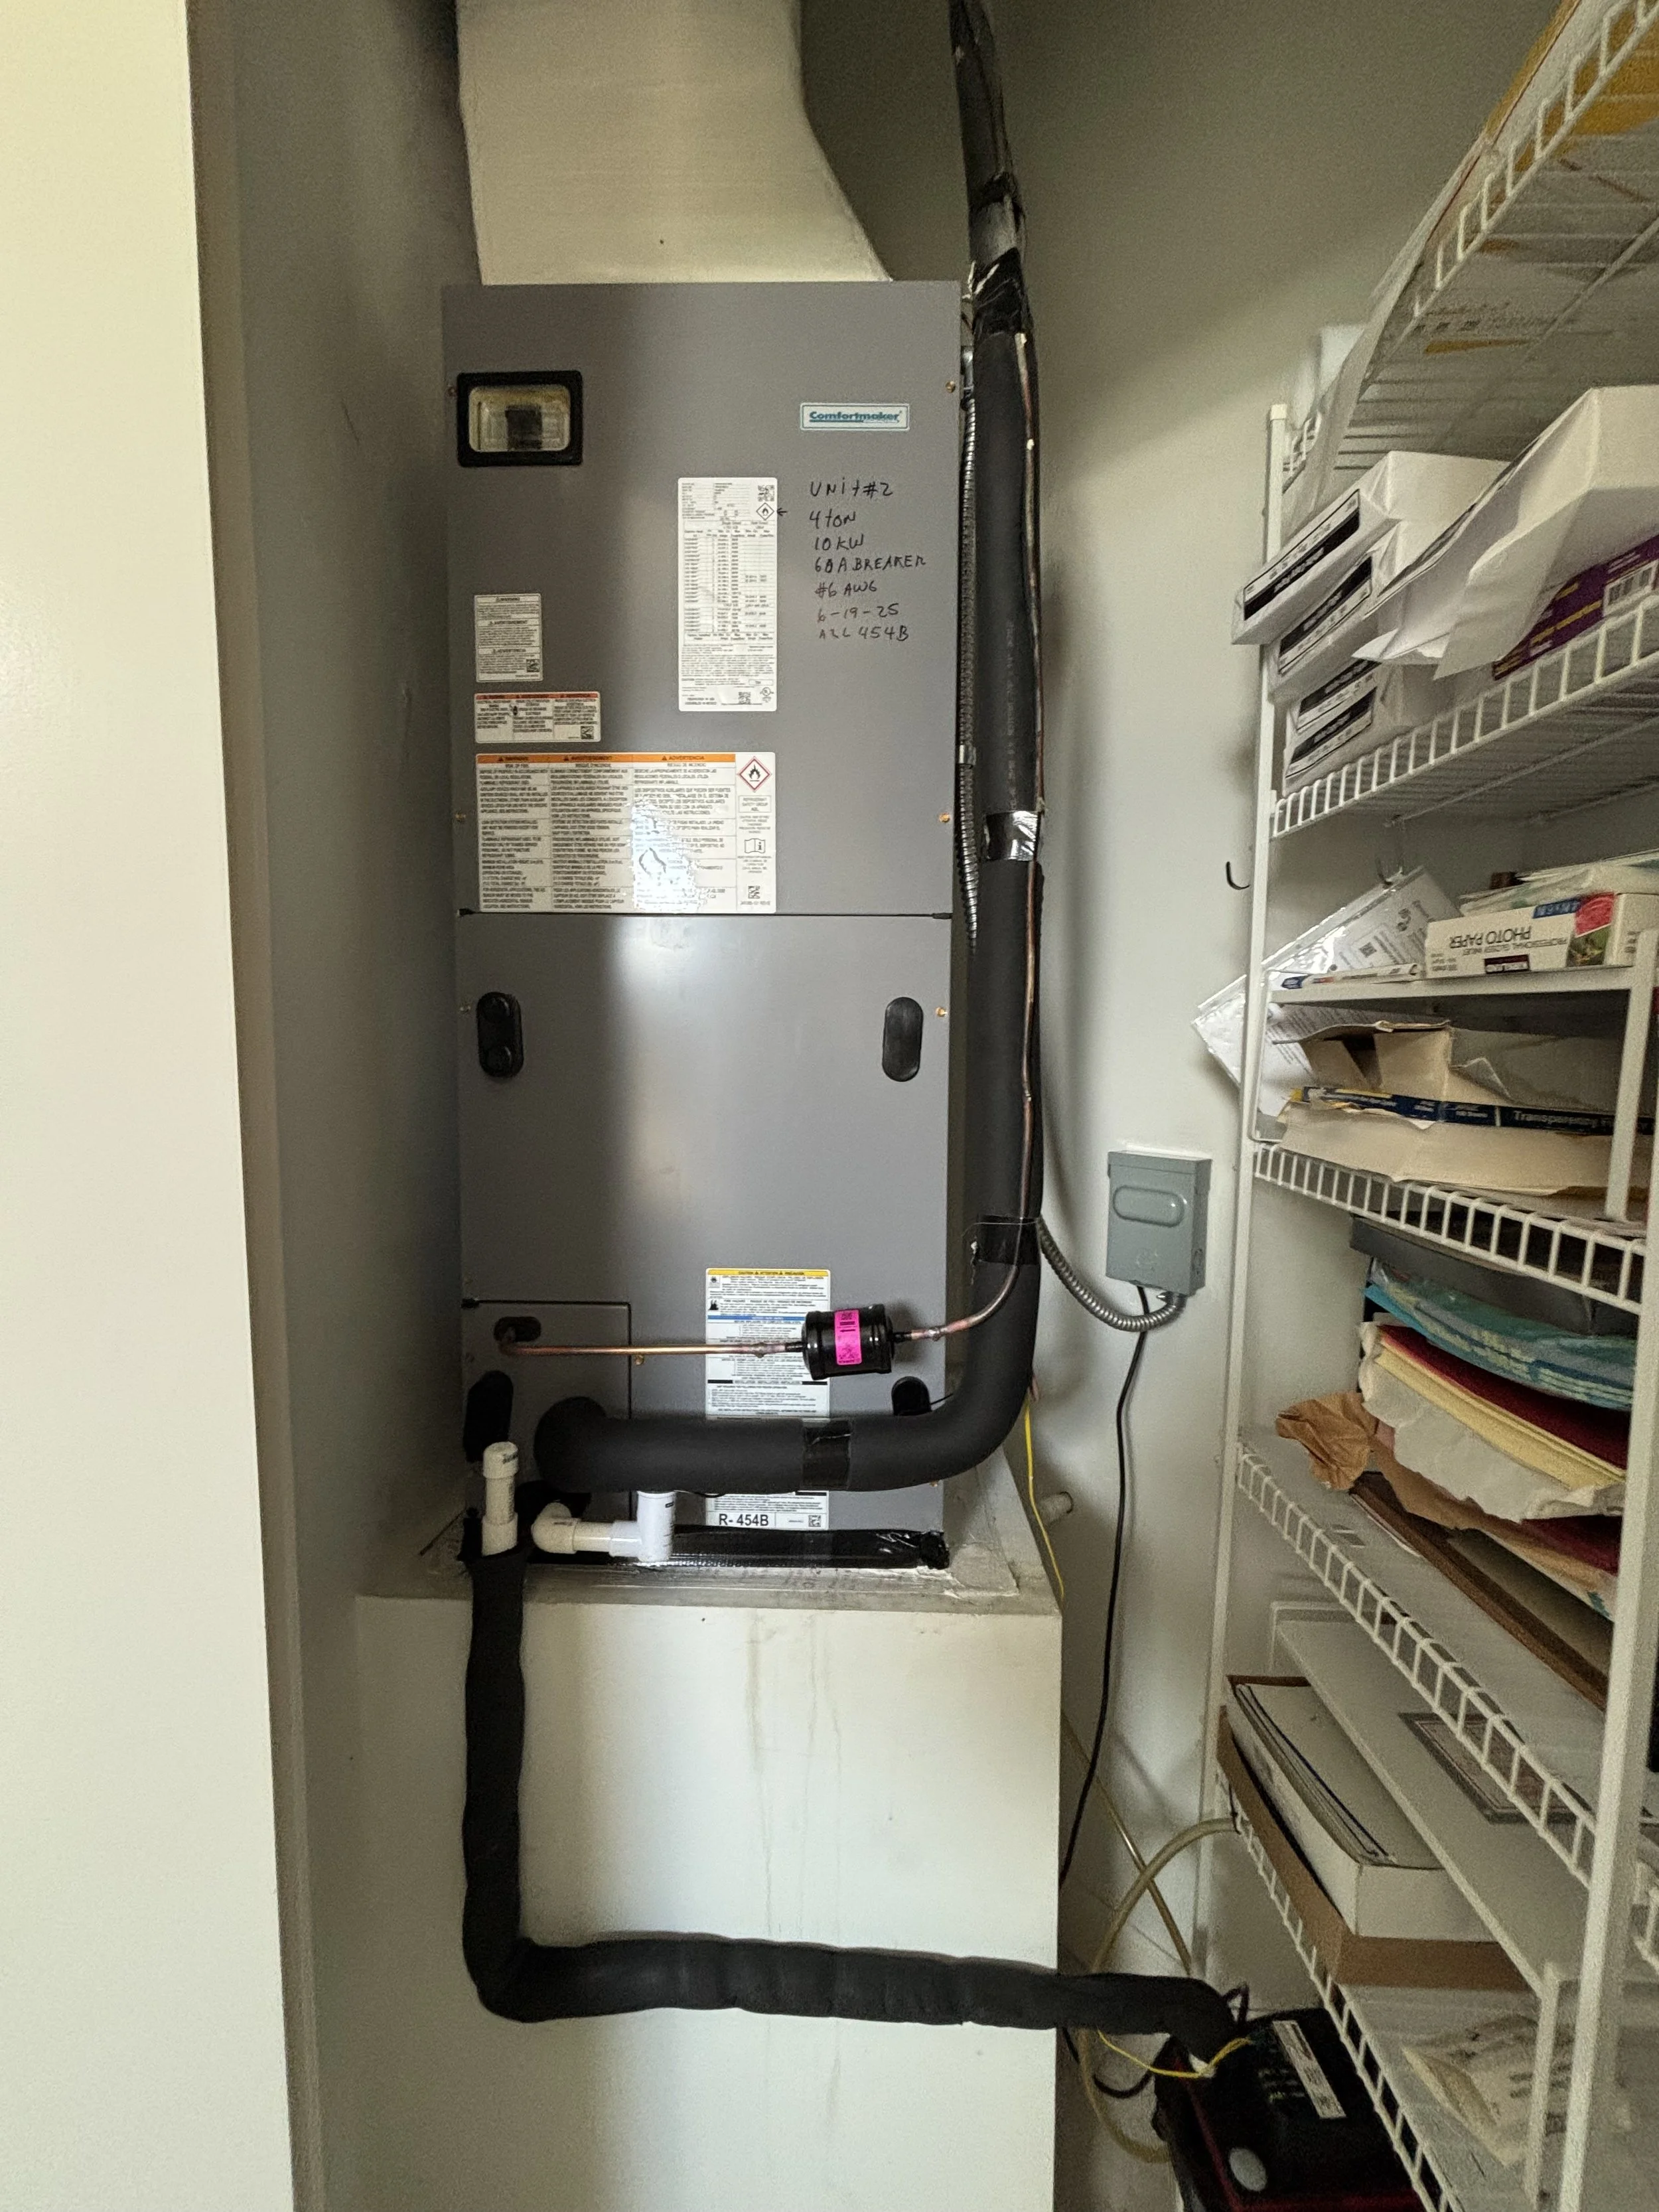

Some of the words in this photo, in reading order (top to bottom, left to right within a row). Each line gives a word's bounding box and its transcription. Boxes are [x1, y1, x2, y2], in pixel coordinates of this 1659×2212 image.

[809, 411, 900, 421] Comfortmaker
[809, 510, 822, 529] 4
[858, 625, 909, 641] 454B
[1449, 932, 1484, 948] PAPER
[1485, 926, 1532, 944] PHOTO
